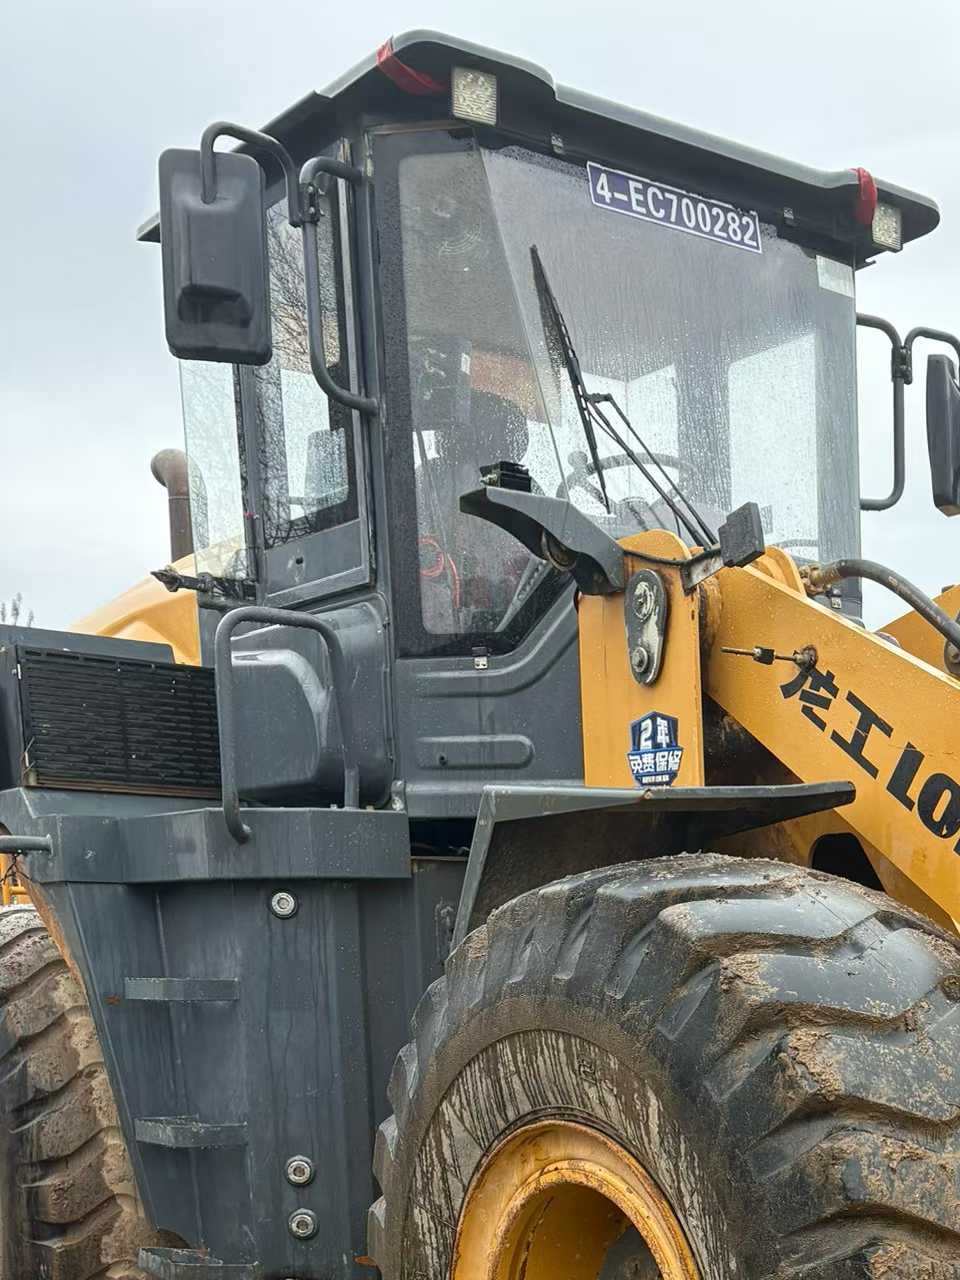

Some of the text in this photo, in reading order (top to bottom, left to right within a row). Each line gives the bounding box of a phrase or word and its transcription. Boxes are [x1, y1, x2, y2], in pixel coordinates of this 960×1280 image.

[596, 173, 757, 247] 4-EC700282
[628, 750, 682, 774] 免费保修
